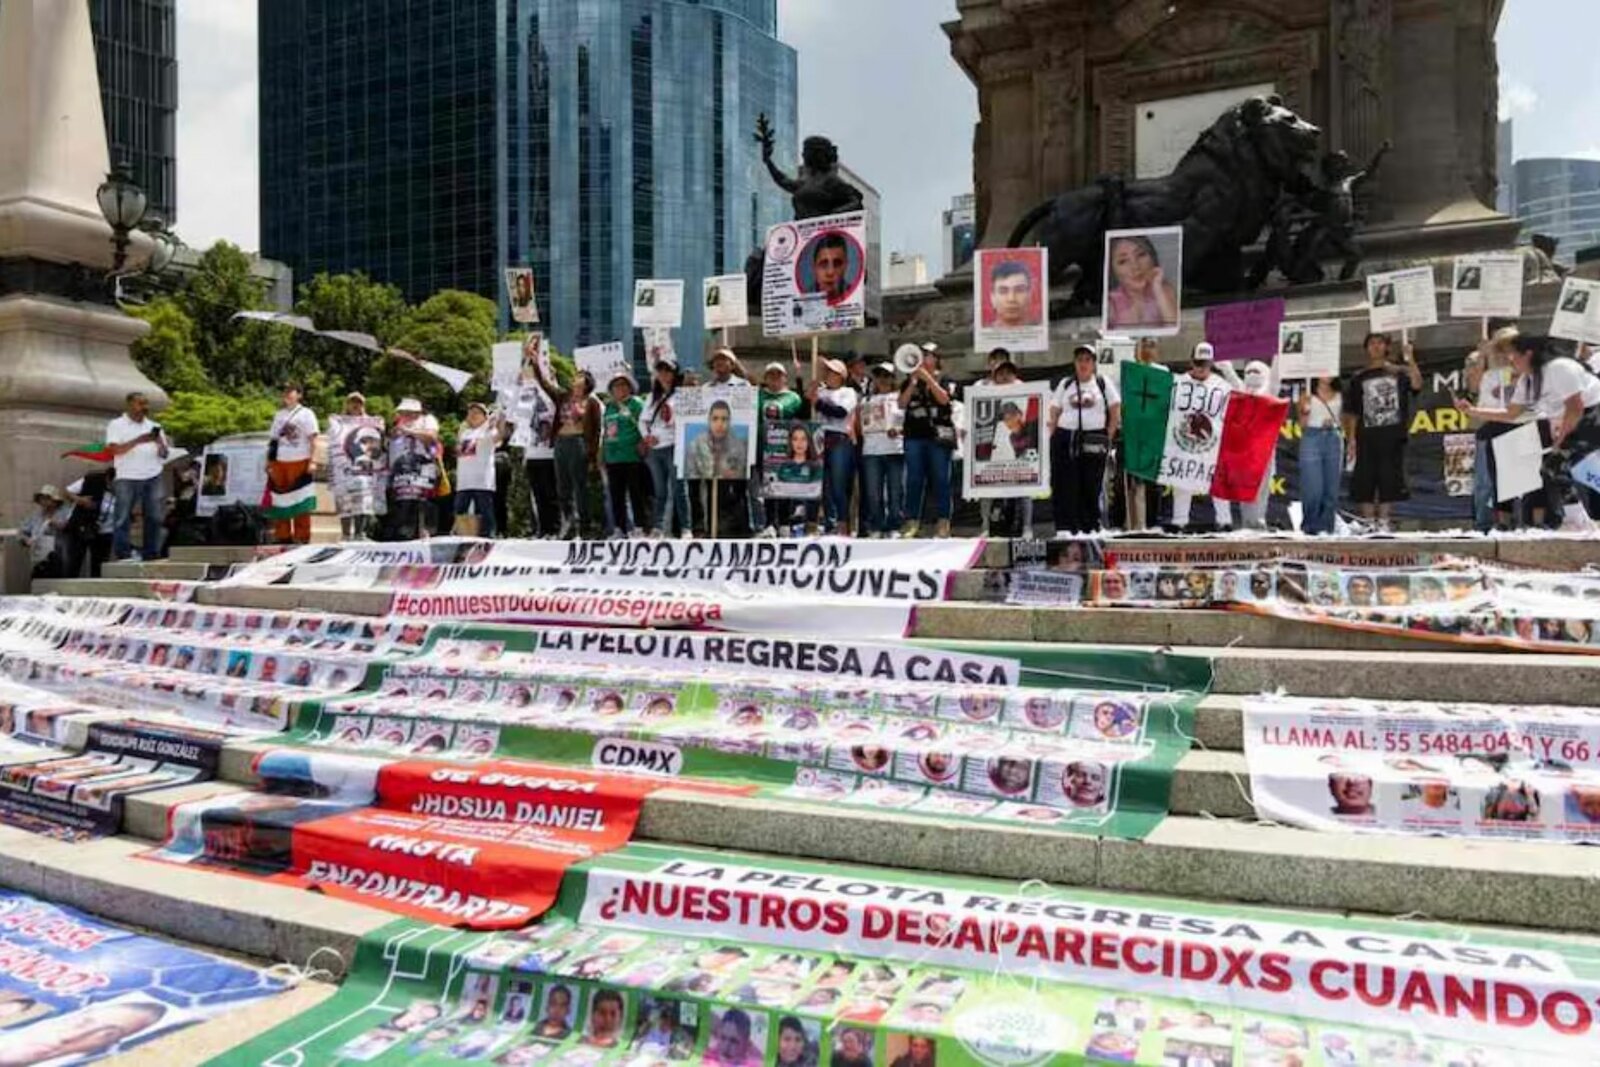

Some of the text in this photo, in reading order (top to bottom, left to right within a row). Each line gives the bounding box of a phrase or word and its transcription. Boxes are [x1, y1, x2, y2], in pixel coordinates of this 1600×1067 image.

[540, 631, 1009, 686] LA PELOTA REGRESA A CASA
[599, 744, 676, 773] CDMX
[1262, 727, 1335, 748] LLAMA
[1343, 730, 1378, 751] AL:
[1385, 732, 1410, 753] 55
[1540, 736, 1555, 762] Y
[1561, 741, 1590, 762] 66
[514, 801, 606, 831] DANIEL
[599, 878, 850, 937] ¿NUESTROS
[861, 903, 1295, 993] DESAPARECIDXS
[662, 862, 1554, 973] LA PELOTA REGRESA A CASA
